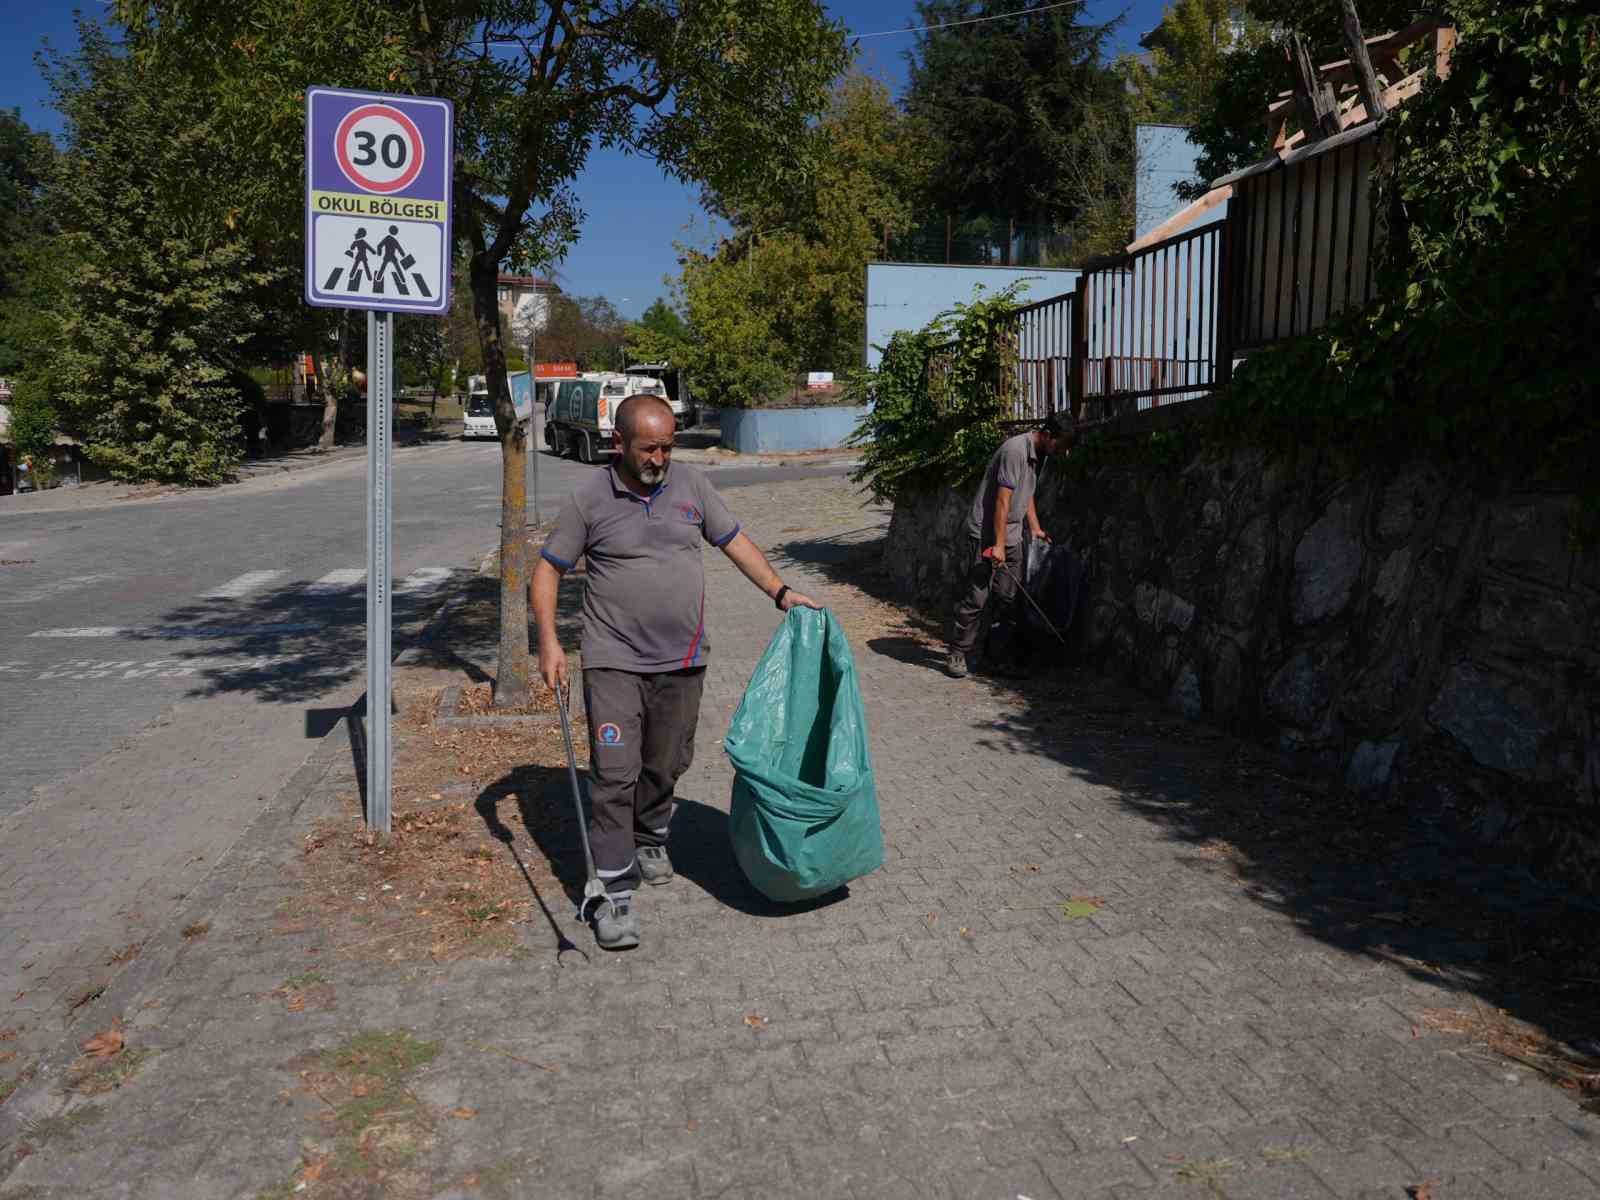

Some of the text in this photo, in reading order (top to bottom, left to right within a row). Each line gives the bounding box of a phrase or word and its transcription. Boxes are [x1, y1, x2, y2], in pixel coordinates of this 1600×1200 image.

[352, 131, 407, 169] 30
[318, 196, 439, 219] OKUL BÖLGESİ
